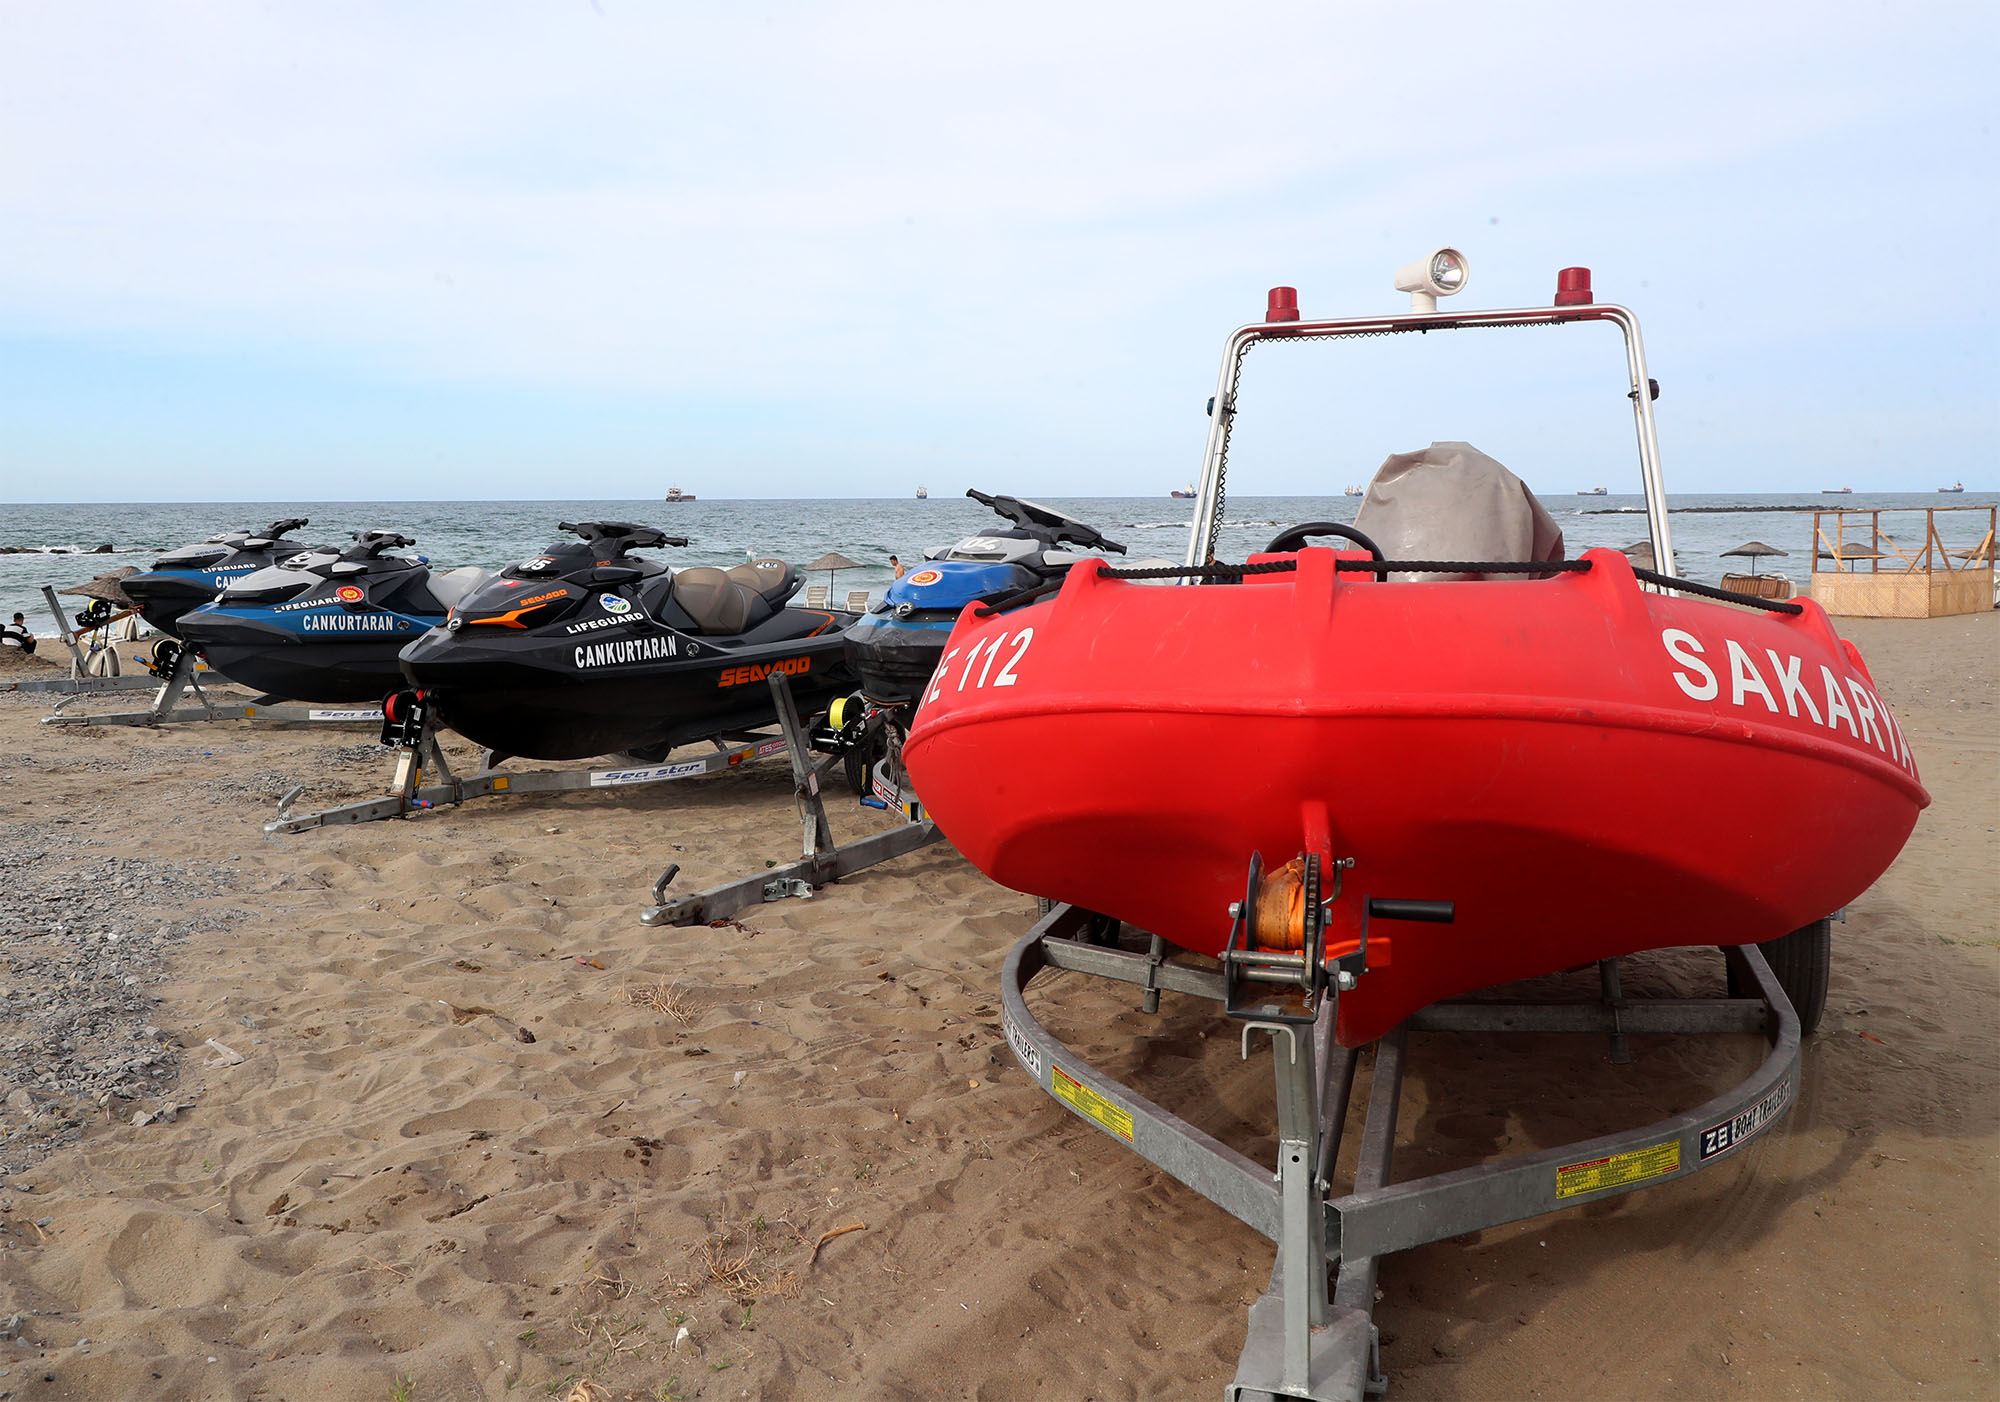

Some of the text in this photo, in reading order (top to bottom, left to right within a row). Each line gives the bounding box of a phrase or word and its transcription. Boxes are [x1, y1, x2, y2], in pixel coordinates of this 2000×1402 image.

[202, 563, 256, 573] LIFEGUARD
[521, 558, 551, 570] 05
[274, 596, 341, 613] LIFEGUARD
[303, 615, 393, 631] CANKURTARAN
[566, 612, 644, 634] LIFEGUARD
[574, 635, 677, 668] CANKURTARAN
[957, 627, 1034, 692] 112
[1662, 628, 1915, 778] SAKARYA
[605, 764, 700, 781] Sea star
[1735, 1107, 1757, 1138] BOAT
